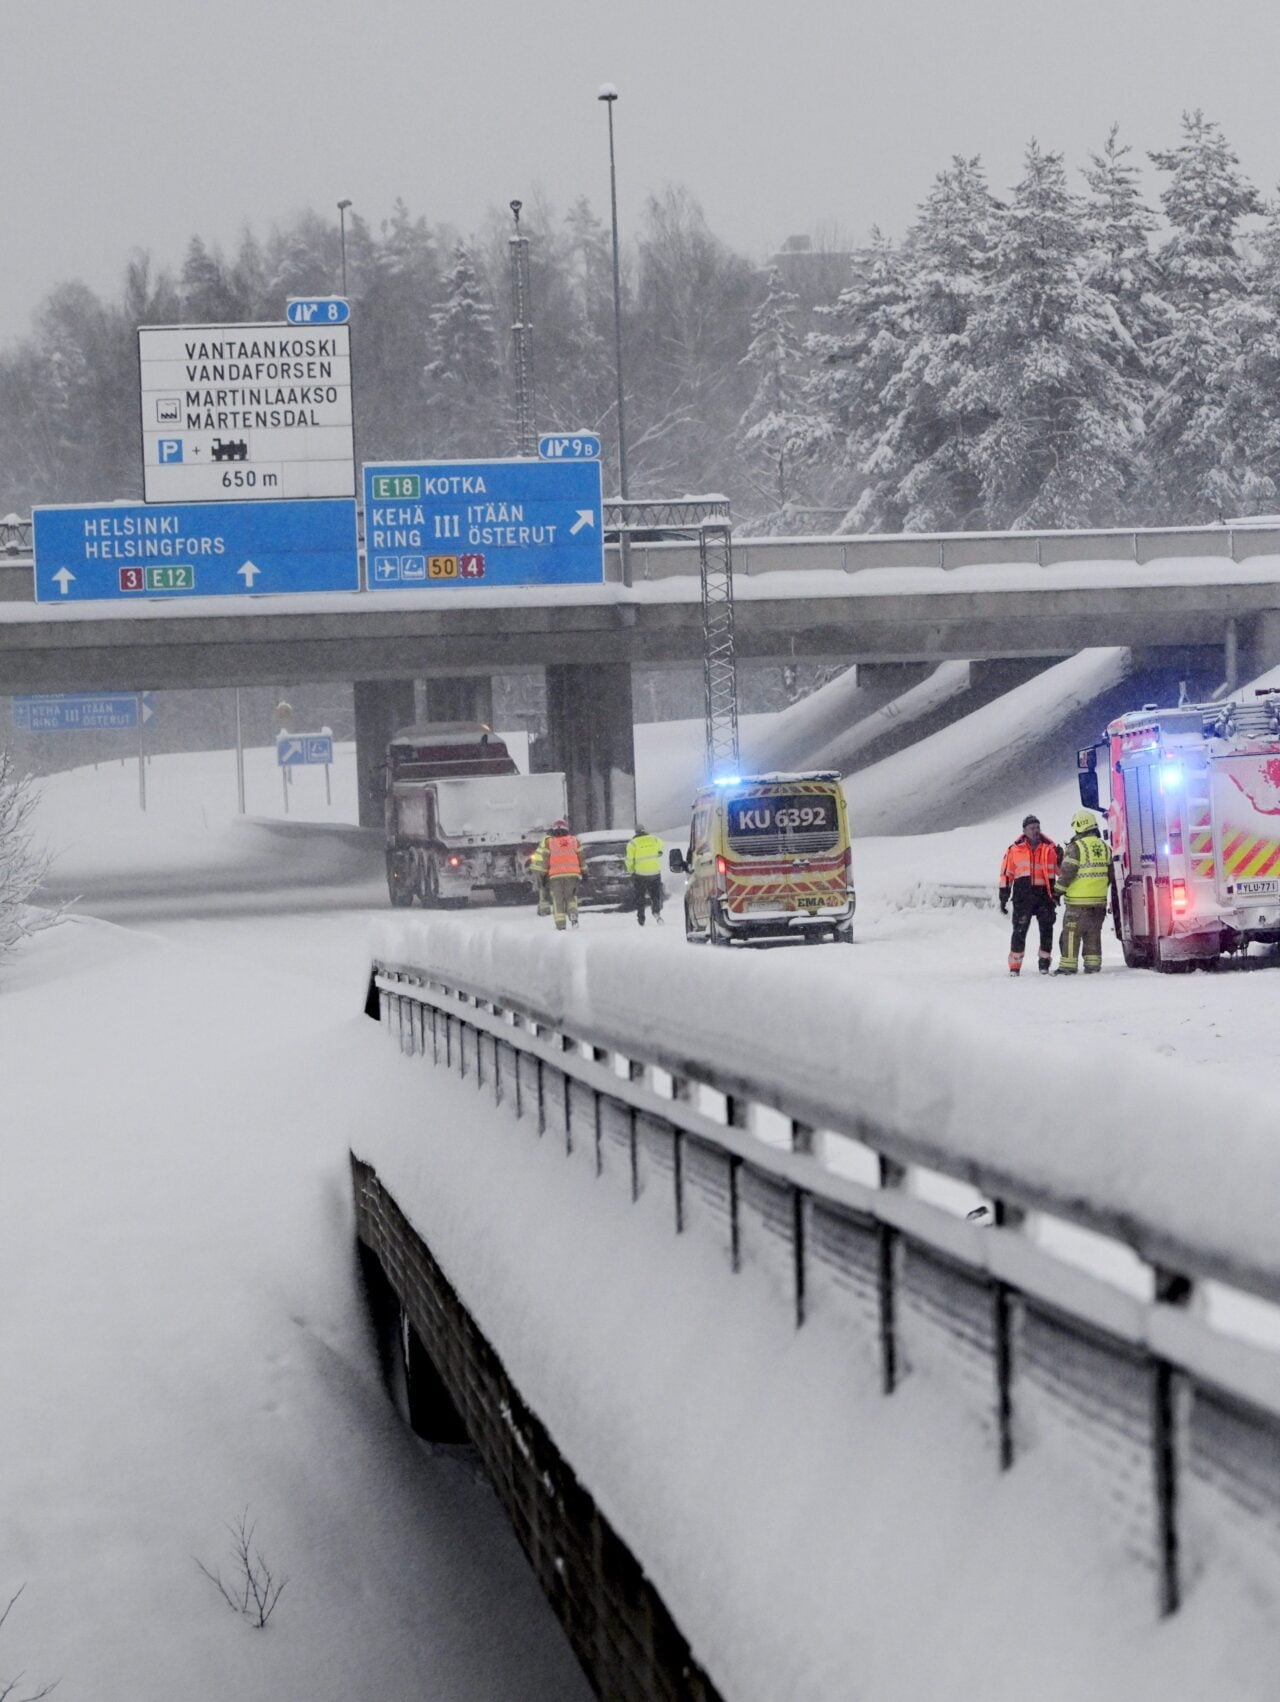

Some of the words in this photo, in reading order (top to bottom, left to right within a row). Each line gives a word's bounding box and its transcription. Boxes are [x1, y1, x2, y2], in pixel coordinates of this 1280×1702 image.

[327, 303, 338, 321] 8
[184, 339, 337, 361] VANTAANKOSKI
[185, 361, 333, 382] VANDAFORSEN
[186, 387, 338, 408] MARTINLAAKSO
[186, 408, 320, 430] MÅRTENSDAL
[222, 470, 256, 488] 650
[263, 473, 277, 487] m
[379, 478, 414, 496] E18
[425, 476, 487, 495] KOTKA
[84, 516, 179, 537] HELSINKI
[372, 505, 425, 527] KEHÄ
[434, 514, 460, 538] III
[467, 502, 524, 524] ITÄÄN
[373, 530, 421, 548] RING
[468, 525, 557, 545] ÖSTERUT
[85, 537, 226, 559] HELSINGFORS
[431, 560, 455, 576] 50
[467, 558, 478, 575] 4
[126, 570, 137, 588] 3
[152, 569, 187, 587] E12
[739, 809, 770, 830] KU
[775, 806, 827, 828] 6392
[798, 896, 826, 907] EMA
